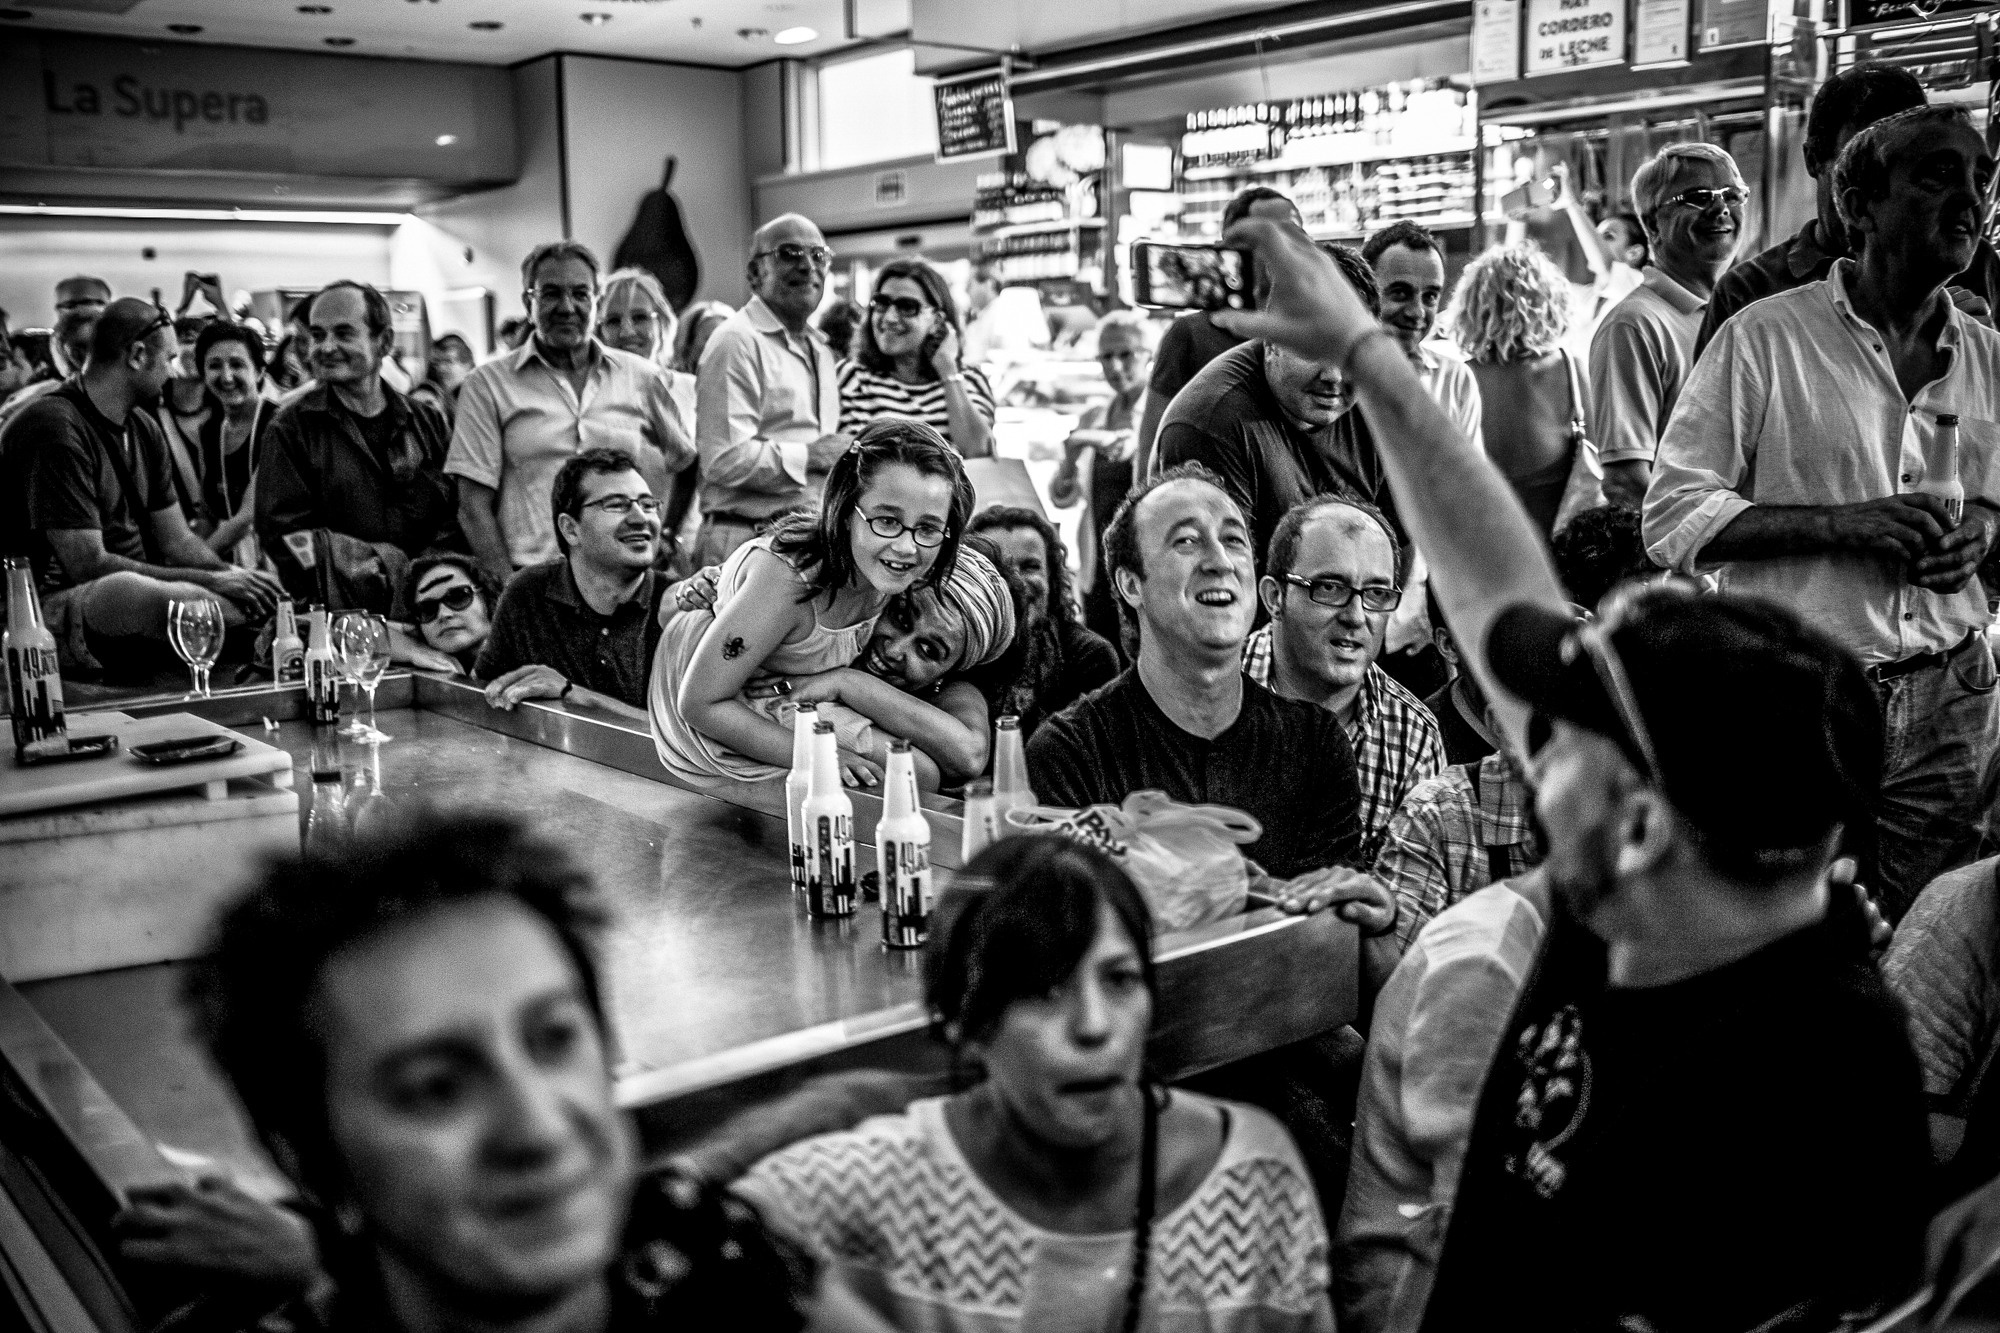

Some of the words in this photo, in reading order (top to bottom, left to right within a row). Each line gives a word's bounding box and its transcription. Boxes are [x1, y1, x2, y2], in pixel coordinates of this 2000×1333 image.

[1538, 12, 1613, 37] CORDERO
[1559, 35, 1609, 57] LECHE
[43, 69, 100, 115] La
[113, 73, 268, 135] Supera
